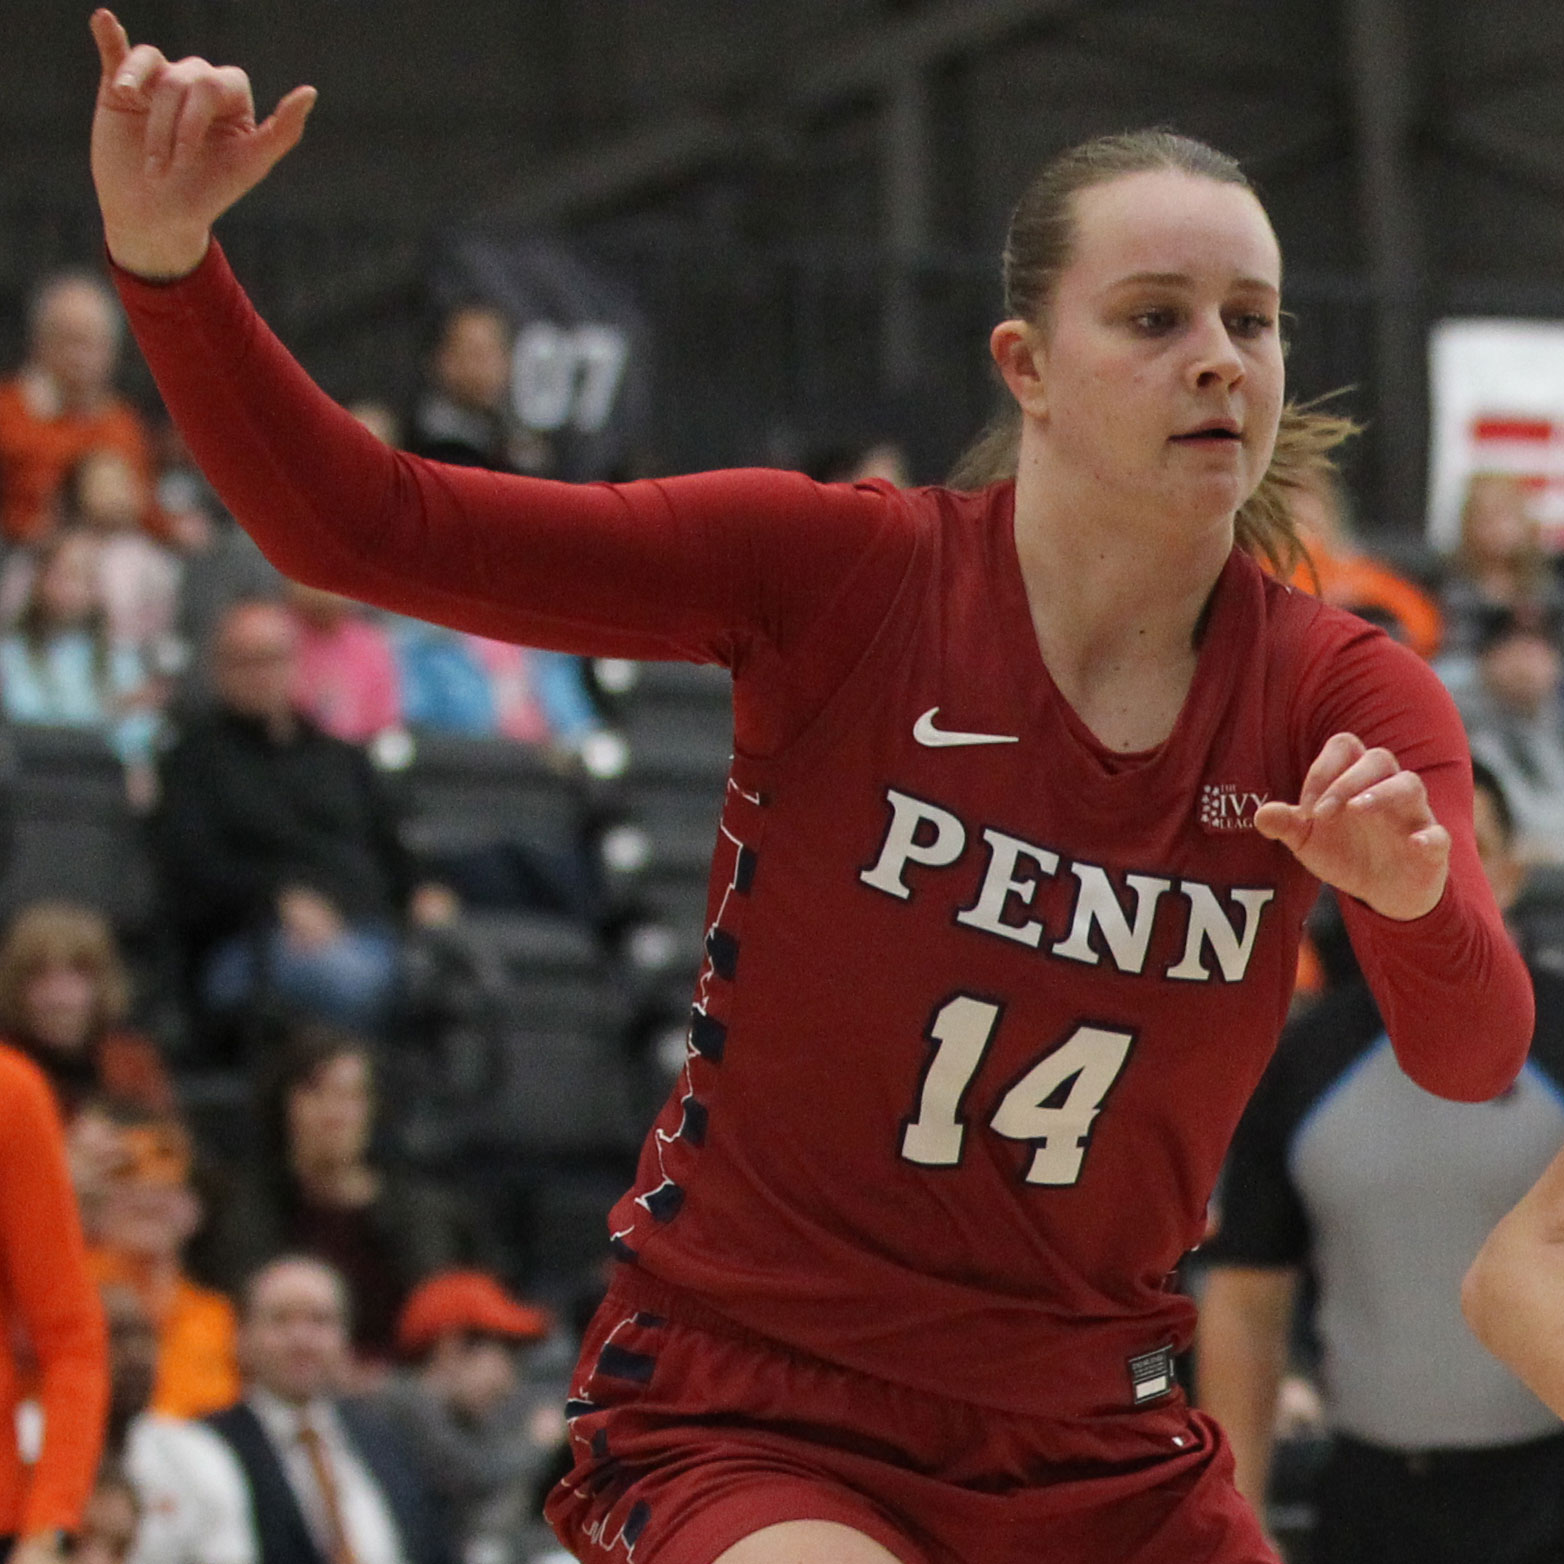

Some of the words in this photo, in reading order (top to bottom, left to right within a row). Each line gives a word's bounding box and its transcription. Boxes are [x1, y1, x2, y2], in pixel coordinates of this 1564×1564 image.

[1220, 792, 1269, 817] IVY
[1220, 818, 1254, 829] LEAG
[859, 788, 1275, 983] PENN
[900, 994, 1135, 1186] 14
